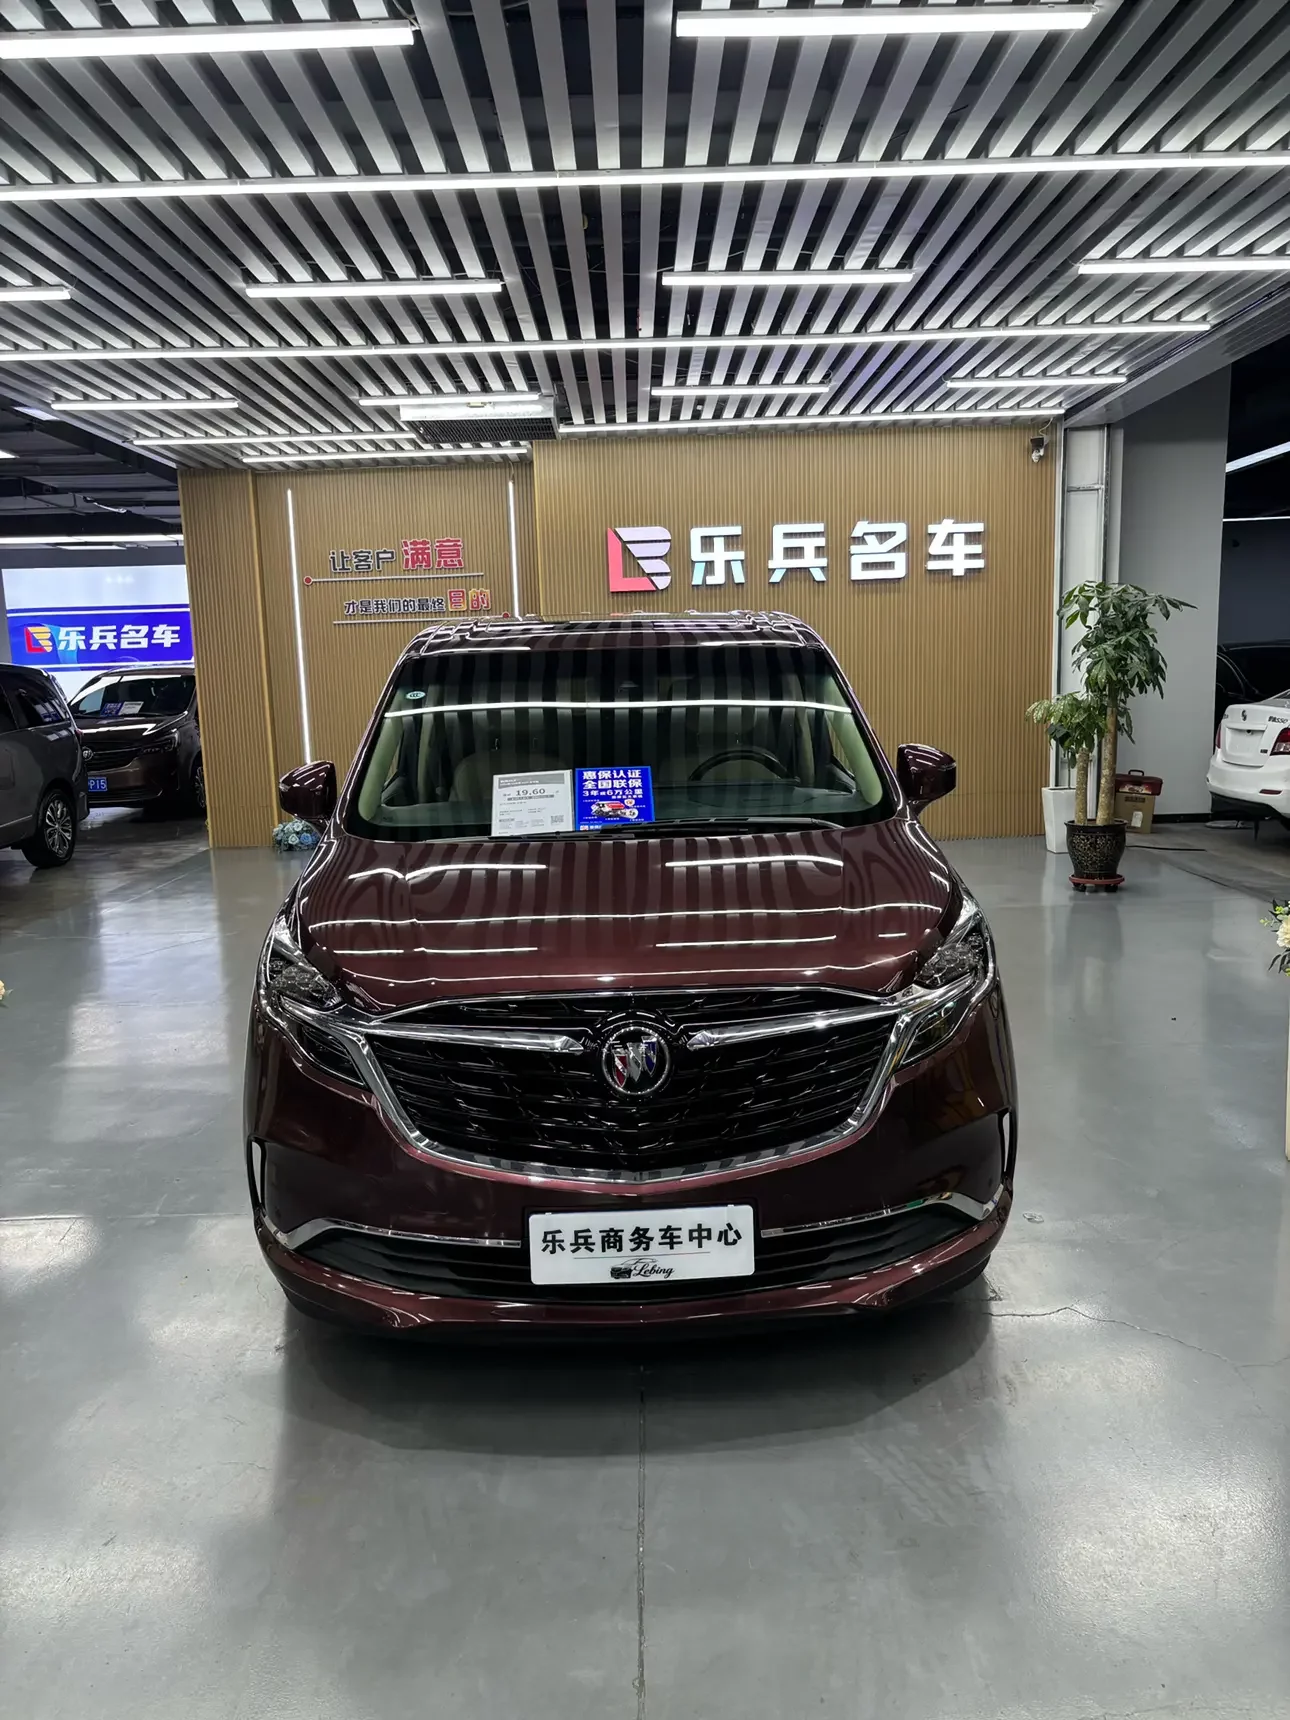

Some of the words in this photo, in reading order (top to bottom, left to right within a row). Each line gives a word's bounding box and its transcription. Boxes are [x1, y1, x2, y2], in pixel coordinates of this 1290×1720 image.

[329, 537, 464, 573] 让客户满意
[690, 518, 985, 586] 乐兵名车
[344, 588, 491, 616] 才是我们的最终目的
[57, 623, 181, 651] 乐兵名车
[88, 779, 107, 790] P15
[583, 769, 642, 780] 惠保认证
[583, 778, 643, 790] 全国联保
[516, 788, 546, 796] 19.60
[541, 1222, 743, 1255] 乐兵商务车中心
[632, 1263, 675, 1278] Lebing
